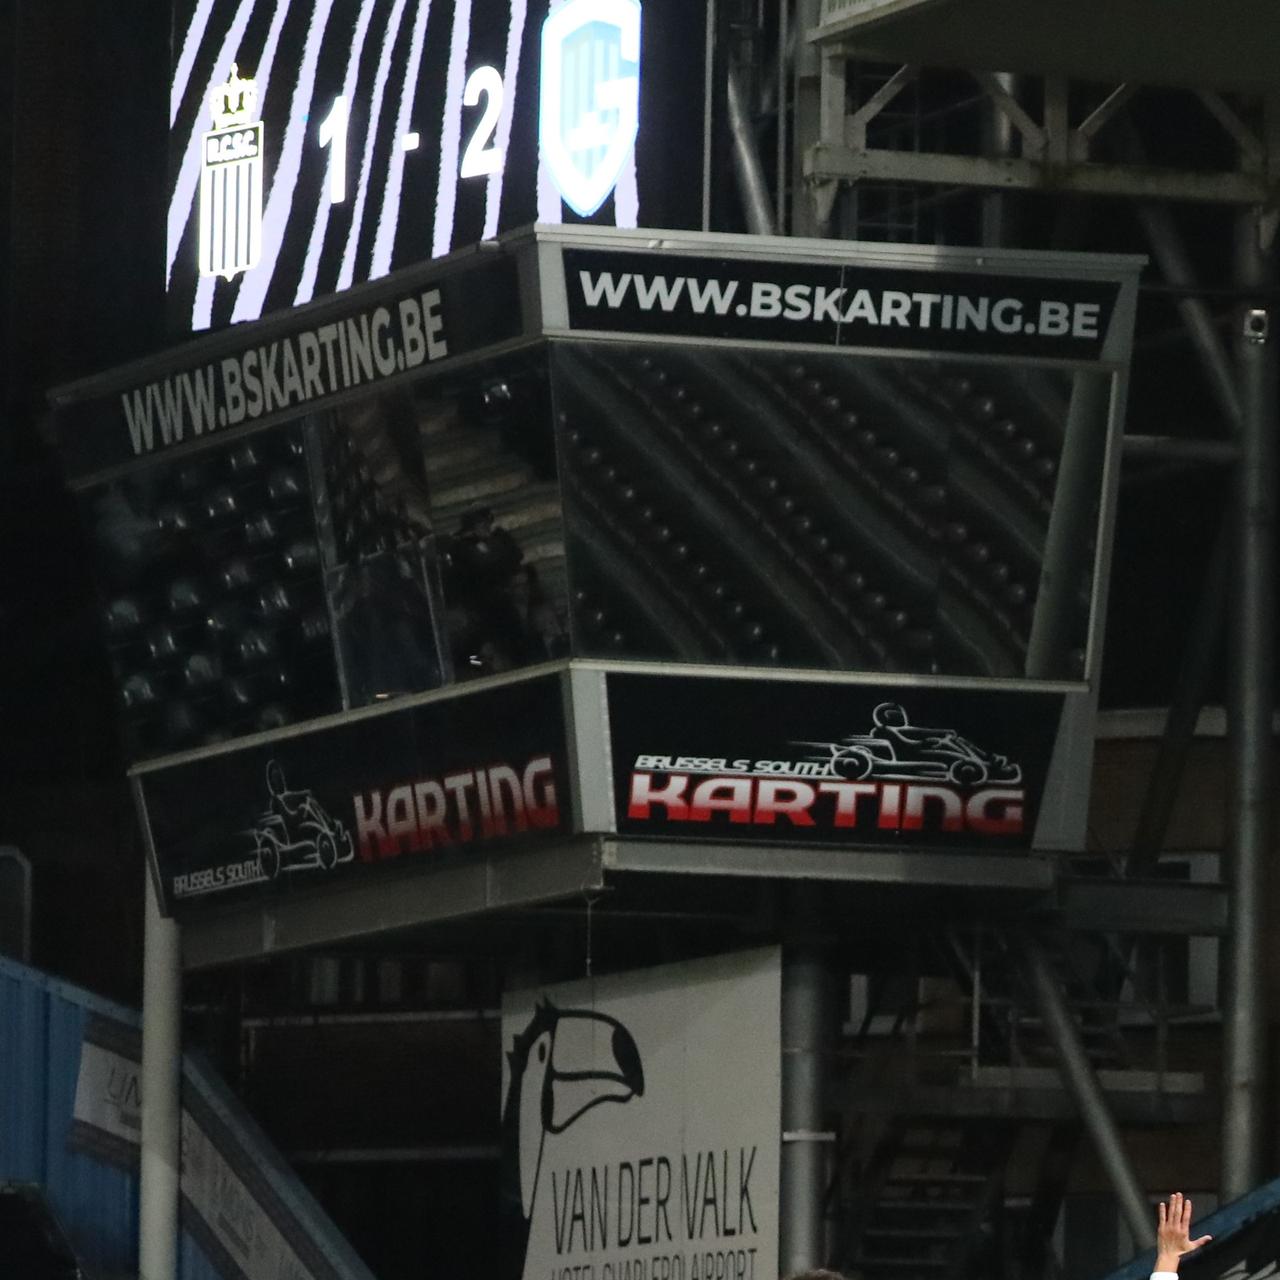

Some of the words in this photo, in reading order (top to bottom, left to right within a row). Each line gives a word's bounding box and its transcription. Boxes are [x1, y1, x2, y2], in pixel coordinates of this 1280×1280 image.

[318, 96, 348, 203] 1
[460, 66, 504, 179] 2
[579, 270, 1101, 340] WWW.BSKARTING.BE
[121, 289, 448, 455] WWW.BSKARTING.BE
[353, 755, 560, 863] KARTING
[627, 773, 1025, 834] KARTING
[551, 1165, 609, 1255] VAN
[617, 1155, 673, 1248] DER
[681, 1145, 758, 1241] VALK
